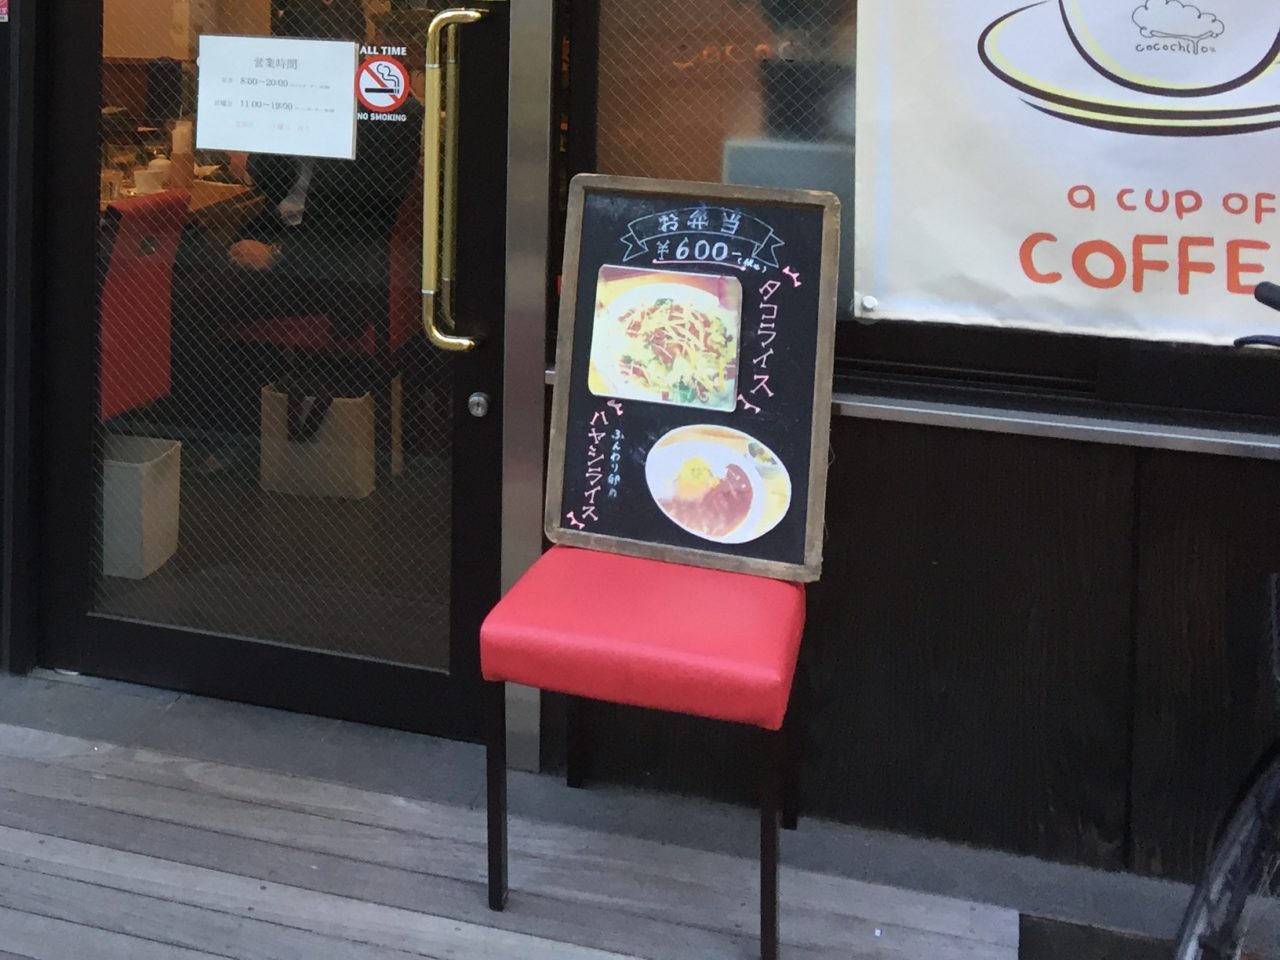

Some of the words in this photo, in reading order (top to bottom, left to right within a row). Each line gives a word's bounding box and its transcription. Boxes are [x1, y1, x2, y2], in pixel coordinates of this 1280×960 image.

[359, 45, 379, 56] ALL
[380, 46, 408, 56] TIME
[357, 112, 369, 122] NO
[370, 112, 408, 123] SMOKING
[657, 208, 742, 236] お弁当
[749, 279, 782, 399] タコライス
[581, 411, 609, 522] ハヤシライス
